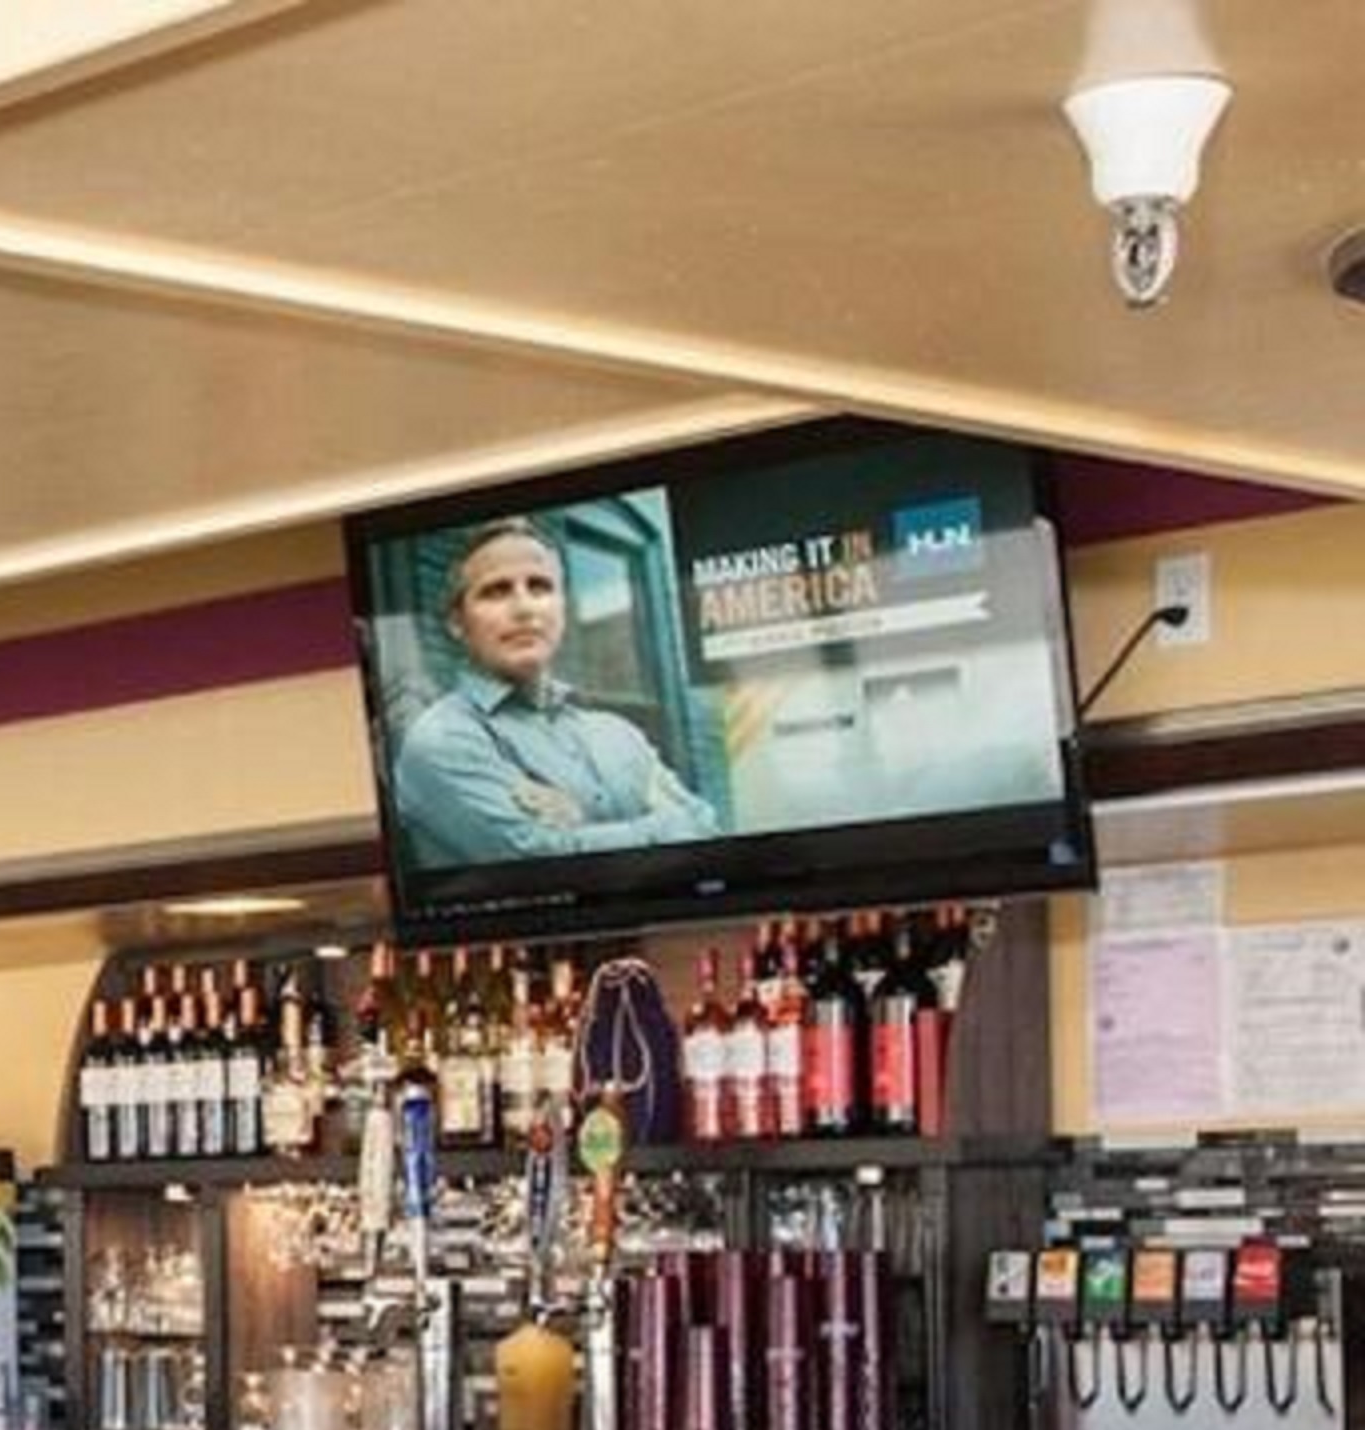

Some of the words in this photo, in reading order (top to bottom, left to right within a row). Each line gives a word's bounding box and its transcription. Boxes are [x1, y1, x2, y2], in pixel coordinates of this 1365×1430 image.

[692, 542, 799, 587] MAKING
[804, 534, 836, 569] IT
[841, 528, 872, 563] IN
[700, 562, 878, 631] AMERICA
